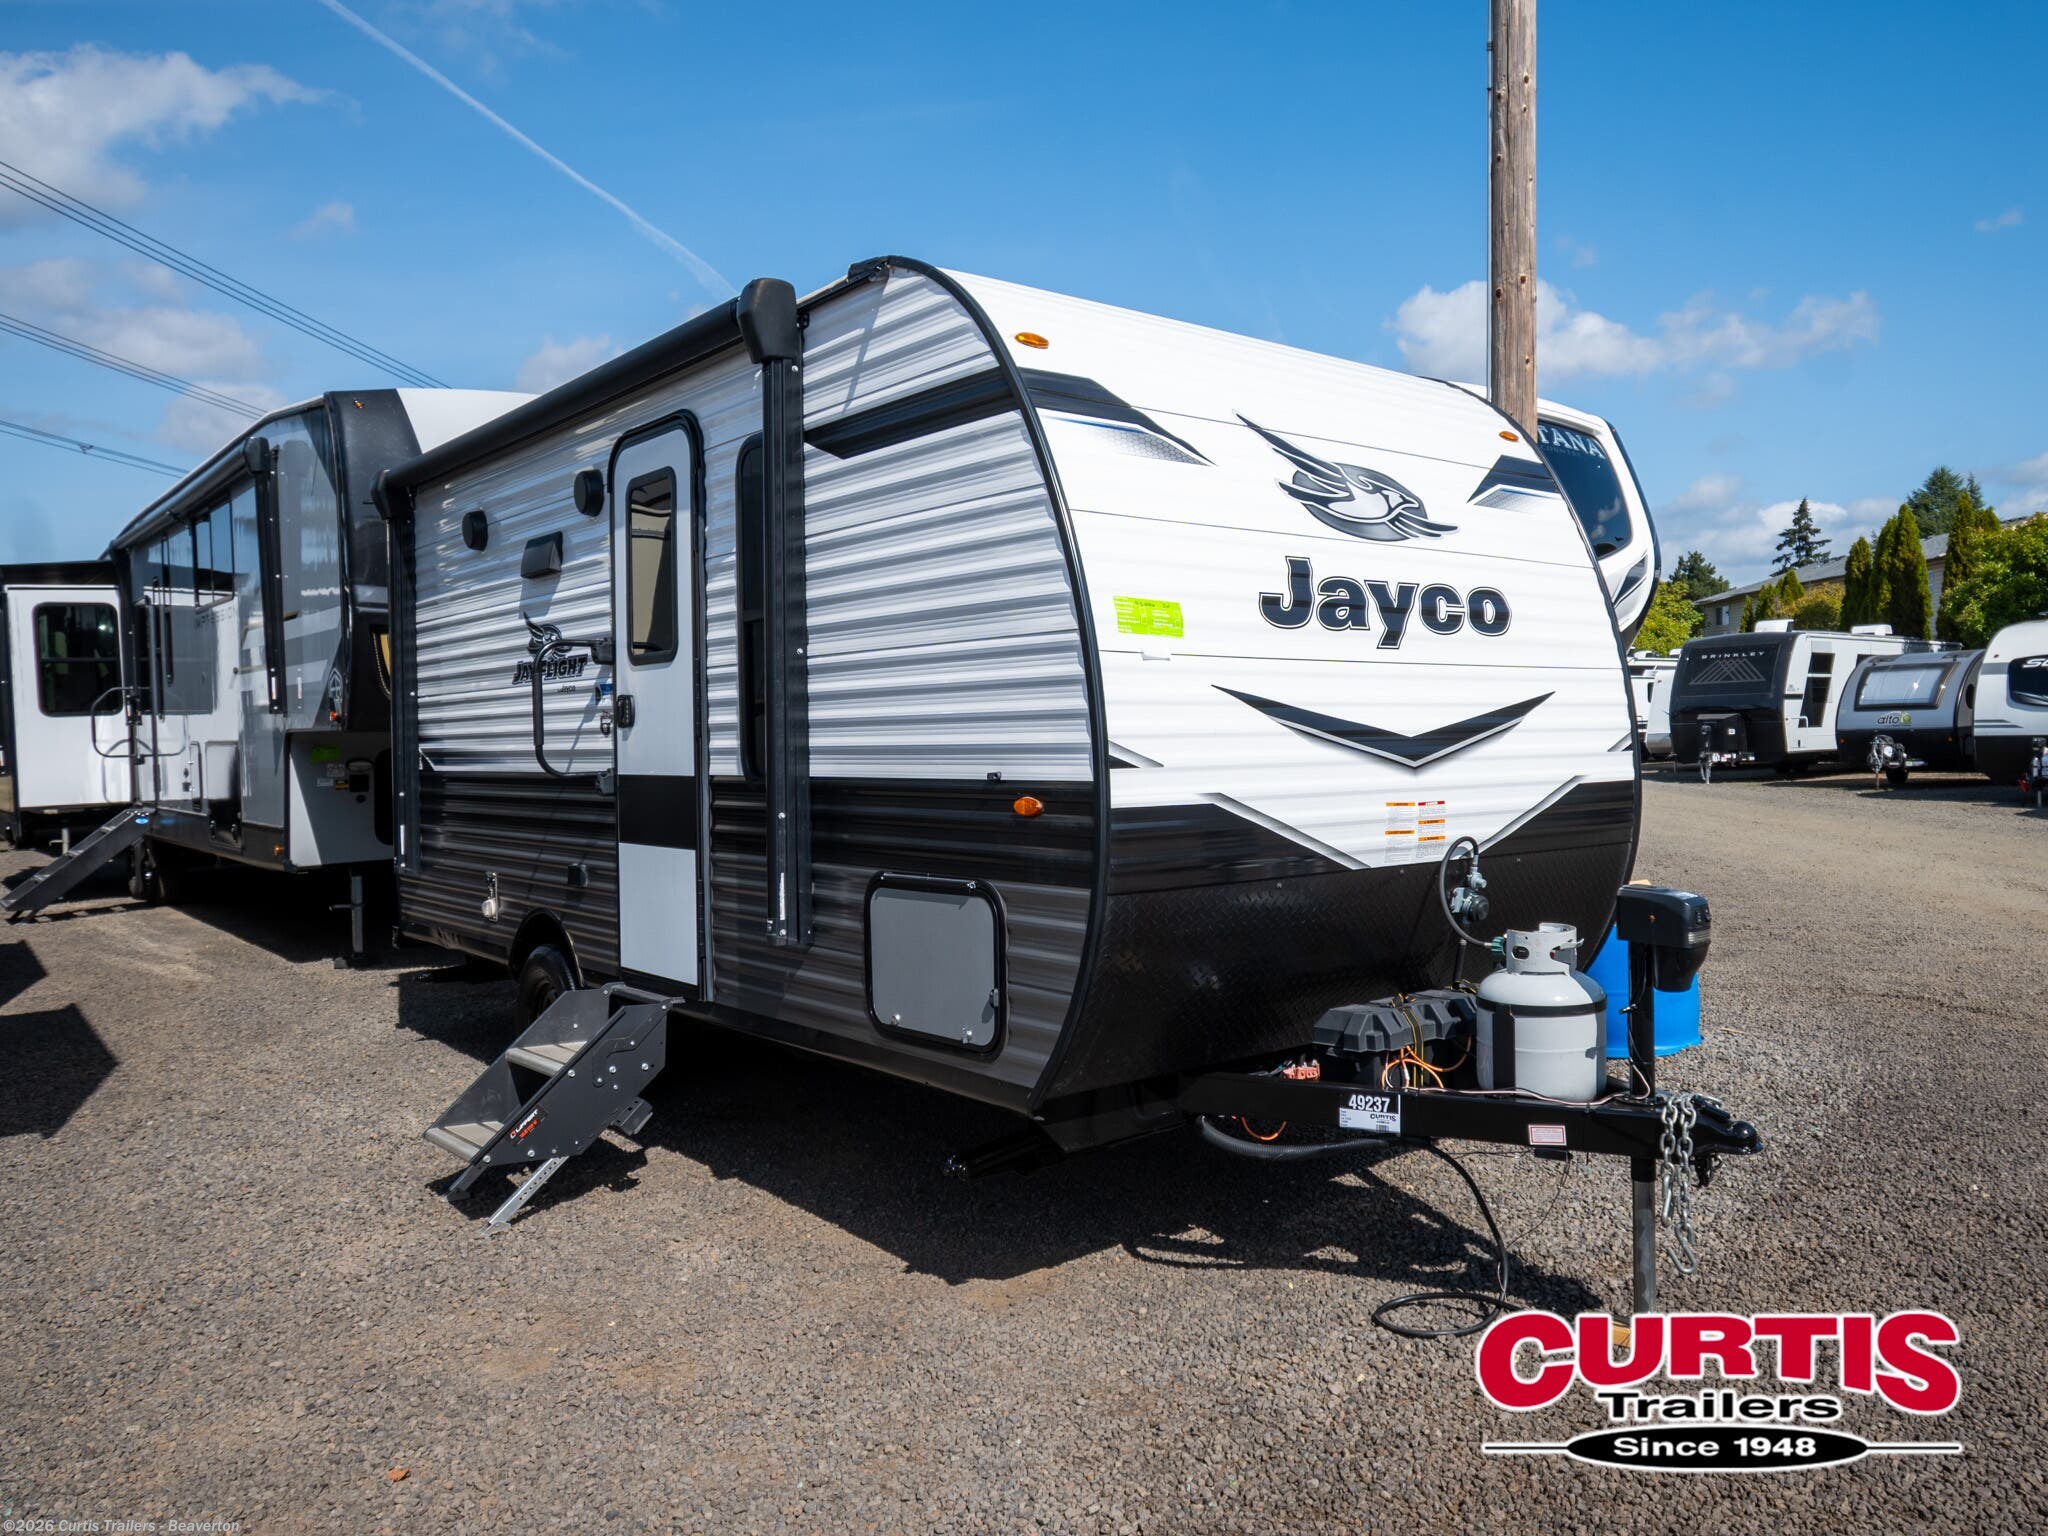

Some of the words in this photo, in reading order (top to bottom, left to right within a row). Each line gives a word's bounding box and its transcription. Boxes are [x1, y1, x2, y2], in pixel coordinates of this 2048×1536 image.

[1259, 556, 1512, 649] Jayco
[1701, 651, 1765, 660] BRINKLEY
[1877, 714, 1900, 725] alto
[1349, 1094, 1391, 1113] 49237
[1370, 1113, 1397, 1122] CURTIS
